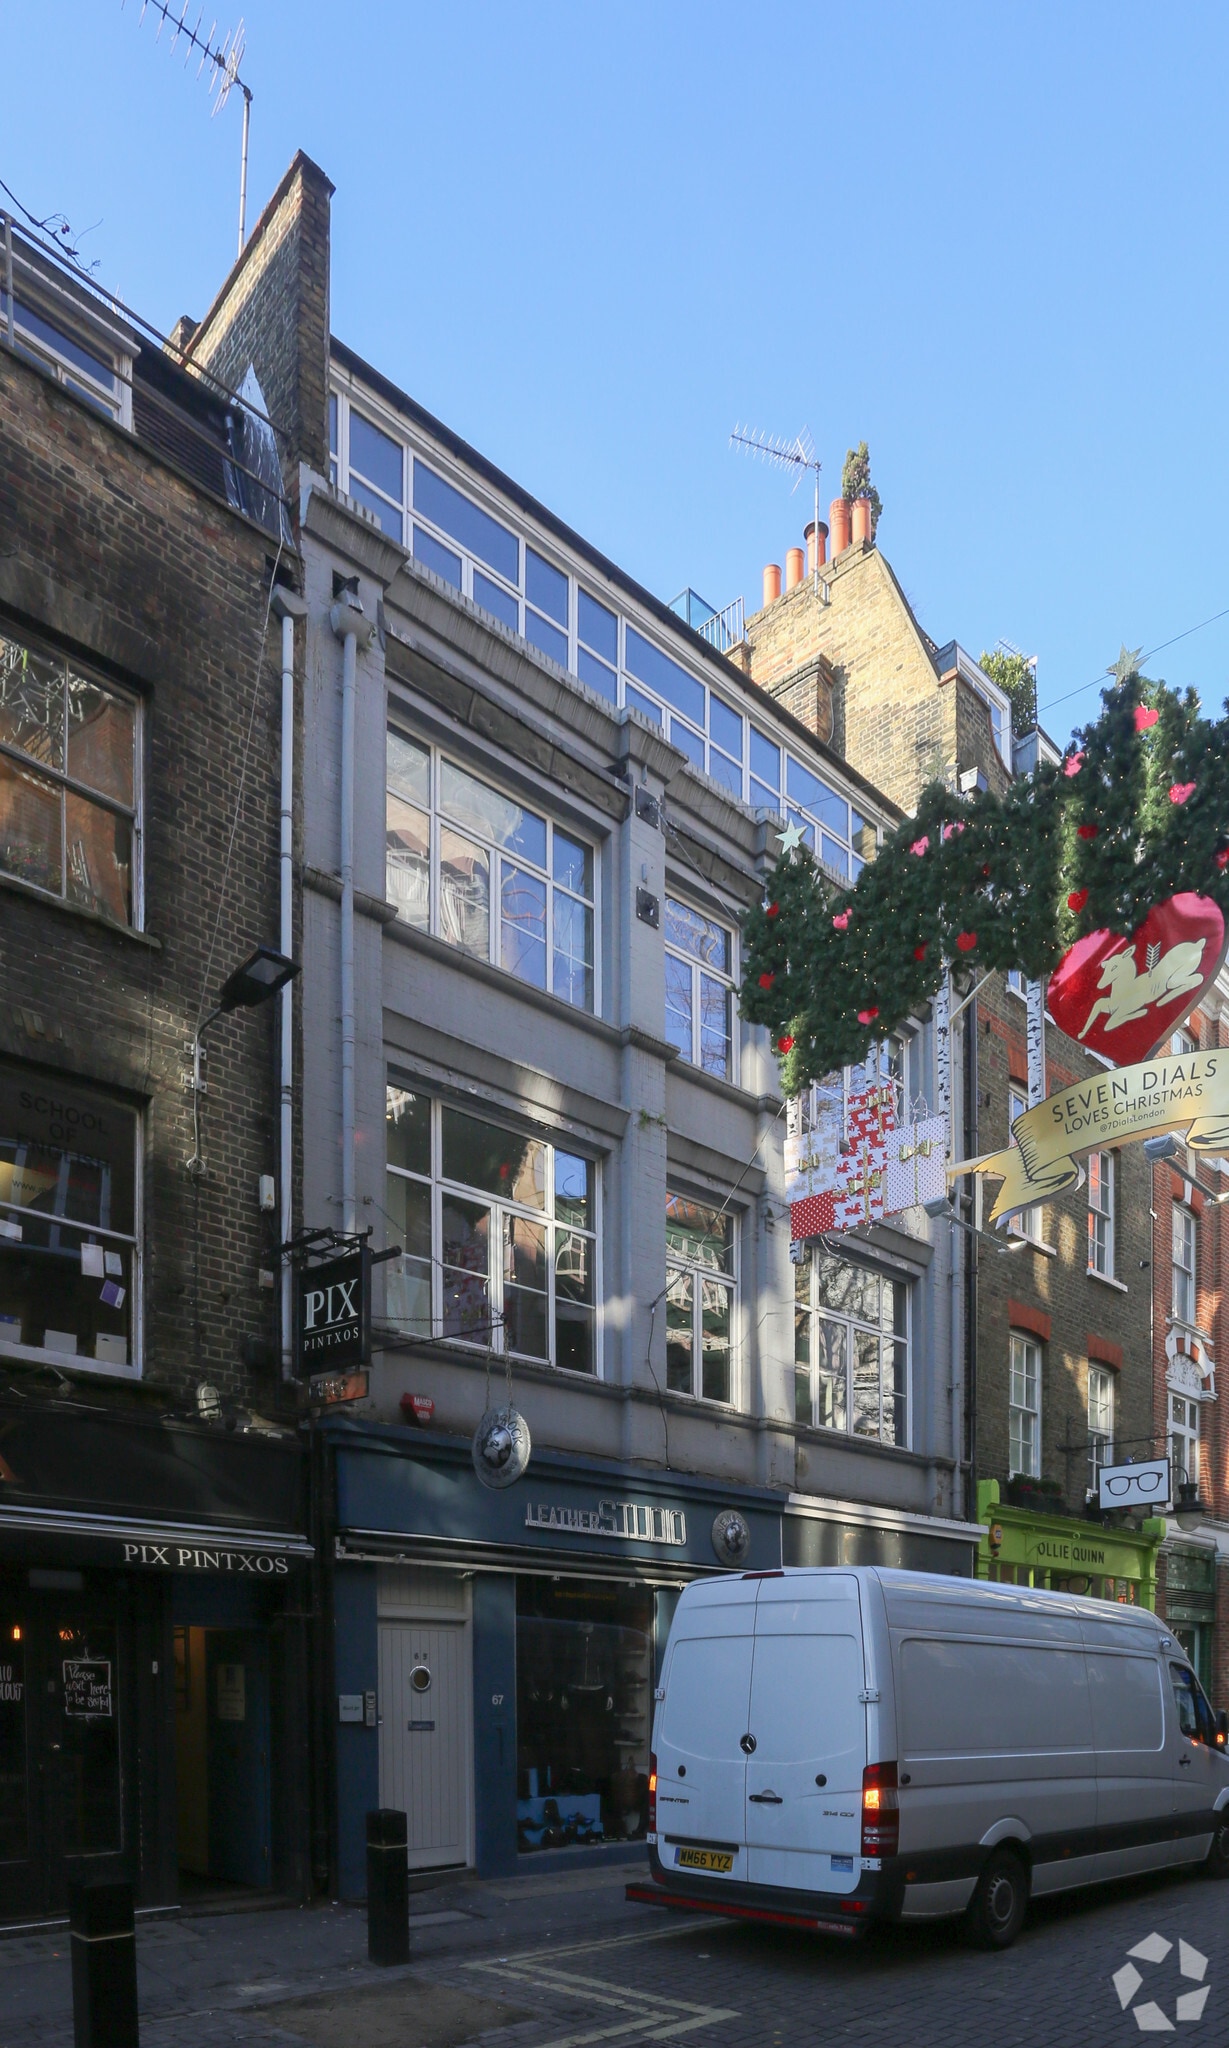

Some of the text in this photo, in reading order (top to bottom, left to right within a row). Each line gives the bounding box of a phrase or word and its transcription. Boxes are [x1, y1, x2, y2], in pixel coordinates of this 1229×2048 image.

[1052, 1059, 1218, 1123] SEVEN DIALS
[20, 1091, 109, 1136] SCHOOL
[1064, 1084, 1203, 1135] LOVES CHRISTMAS
[1100, 1108, 1165, 1132] @7DialsLondon
[49, 1123, 77, 1142] OF
[304, 1278, 358, 1330] PIX
[304, 1327, 359, 1351] PINTXOS
[525, 1500, 687, 1546] LEATHER STUDIO
[123, 1543, 289, 1574] PIX PINTXOS
[1037, 1542, 1105, 1564] OLLIE QUINN
[492, 1695, 504, 1705] 67
[710, 1854, 731, 1869] YYZ
